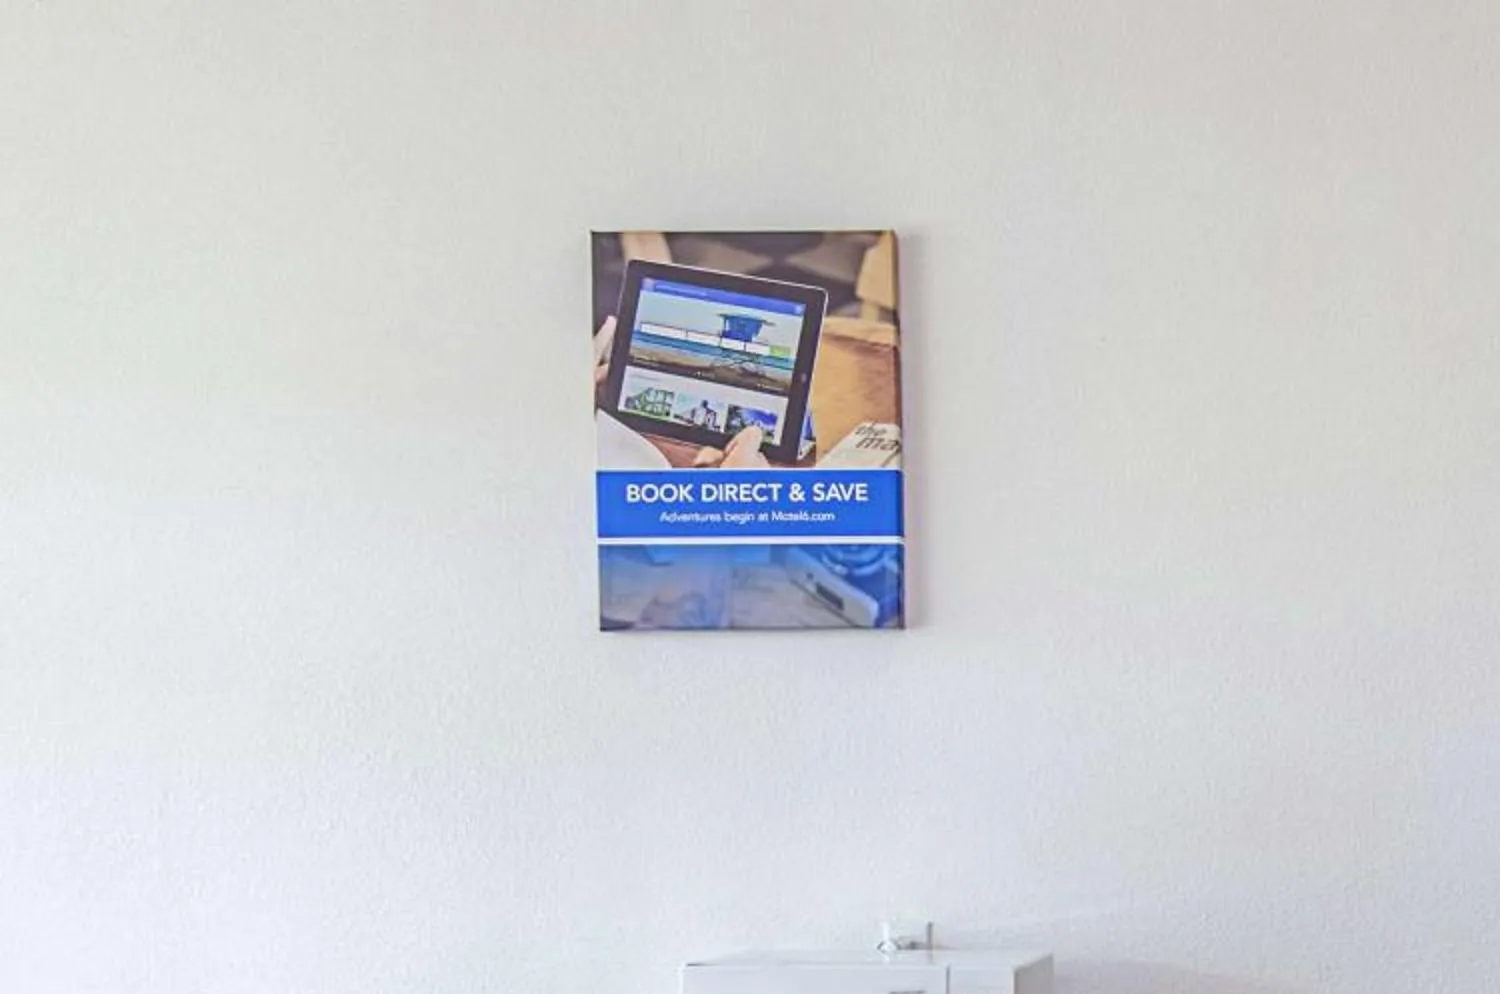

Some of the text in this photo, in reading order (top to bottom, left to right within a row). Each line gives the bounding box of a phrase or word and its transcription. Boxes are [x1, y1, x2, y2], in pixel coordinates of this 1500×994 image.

[626, 483, 869, 503] BOOK DIRECT & SAVE
[659, 509, 835, 525] Adventures begin at Motel6.com
